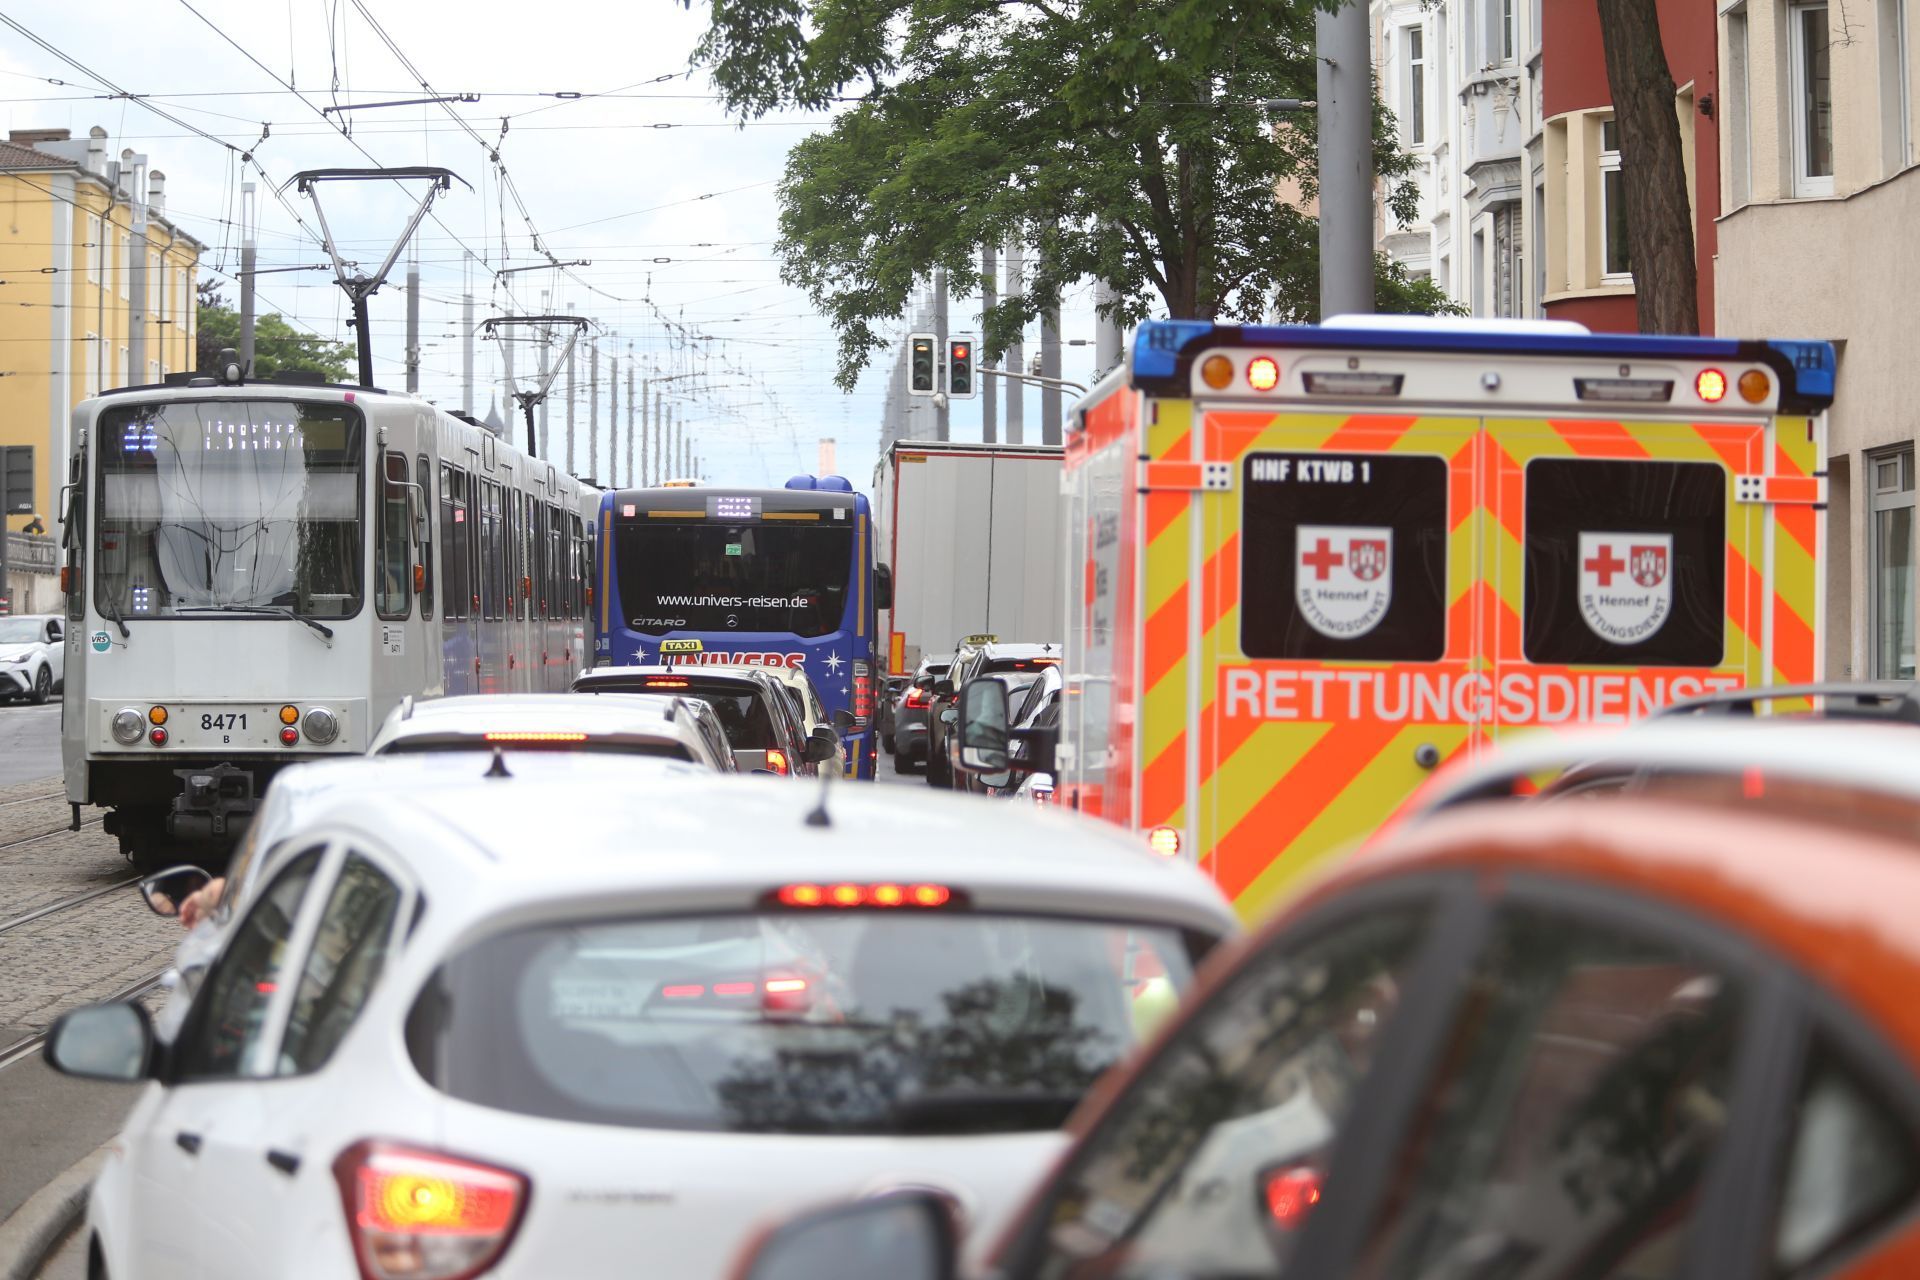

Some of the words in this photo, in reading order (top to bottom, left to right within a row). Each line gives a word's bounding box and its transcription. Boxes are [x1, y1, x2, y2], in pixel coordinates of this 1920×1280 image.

[1251, 458, 1290, 481] HNF
[1296, 460, 1355, 483] KTWB
[1361, 461, 1371, 483] 1
[656, 594, 808, 608] www.univers-reisen.de
[1316, 588, 1369, 601] Hennef
[1599, 594, 1651, 607] Hennef
[1299, 588, 1387, 636] RETTUNGSDIENST
[1582, 594, 1667, 640] RETTUNGSDIENST
[632, 618, 686, 626] CITARO
[667, 642, 695, 650] TAXI
[200, 713, 248, 731] 8471
[223, 735, 230, 744] B
